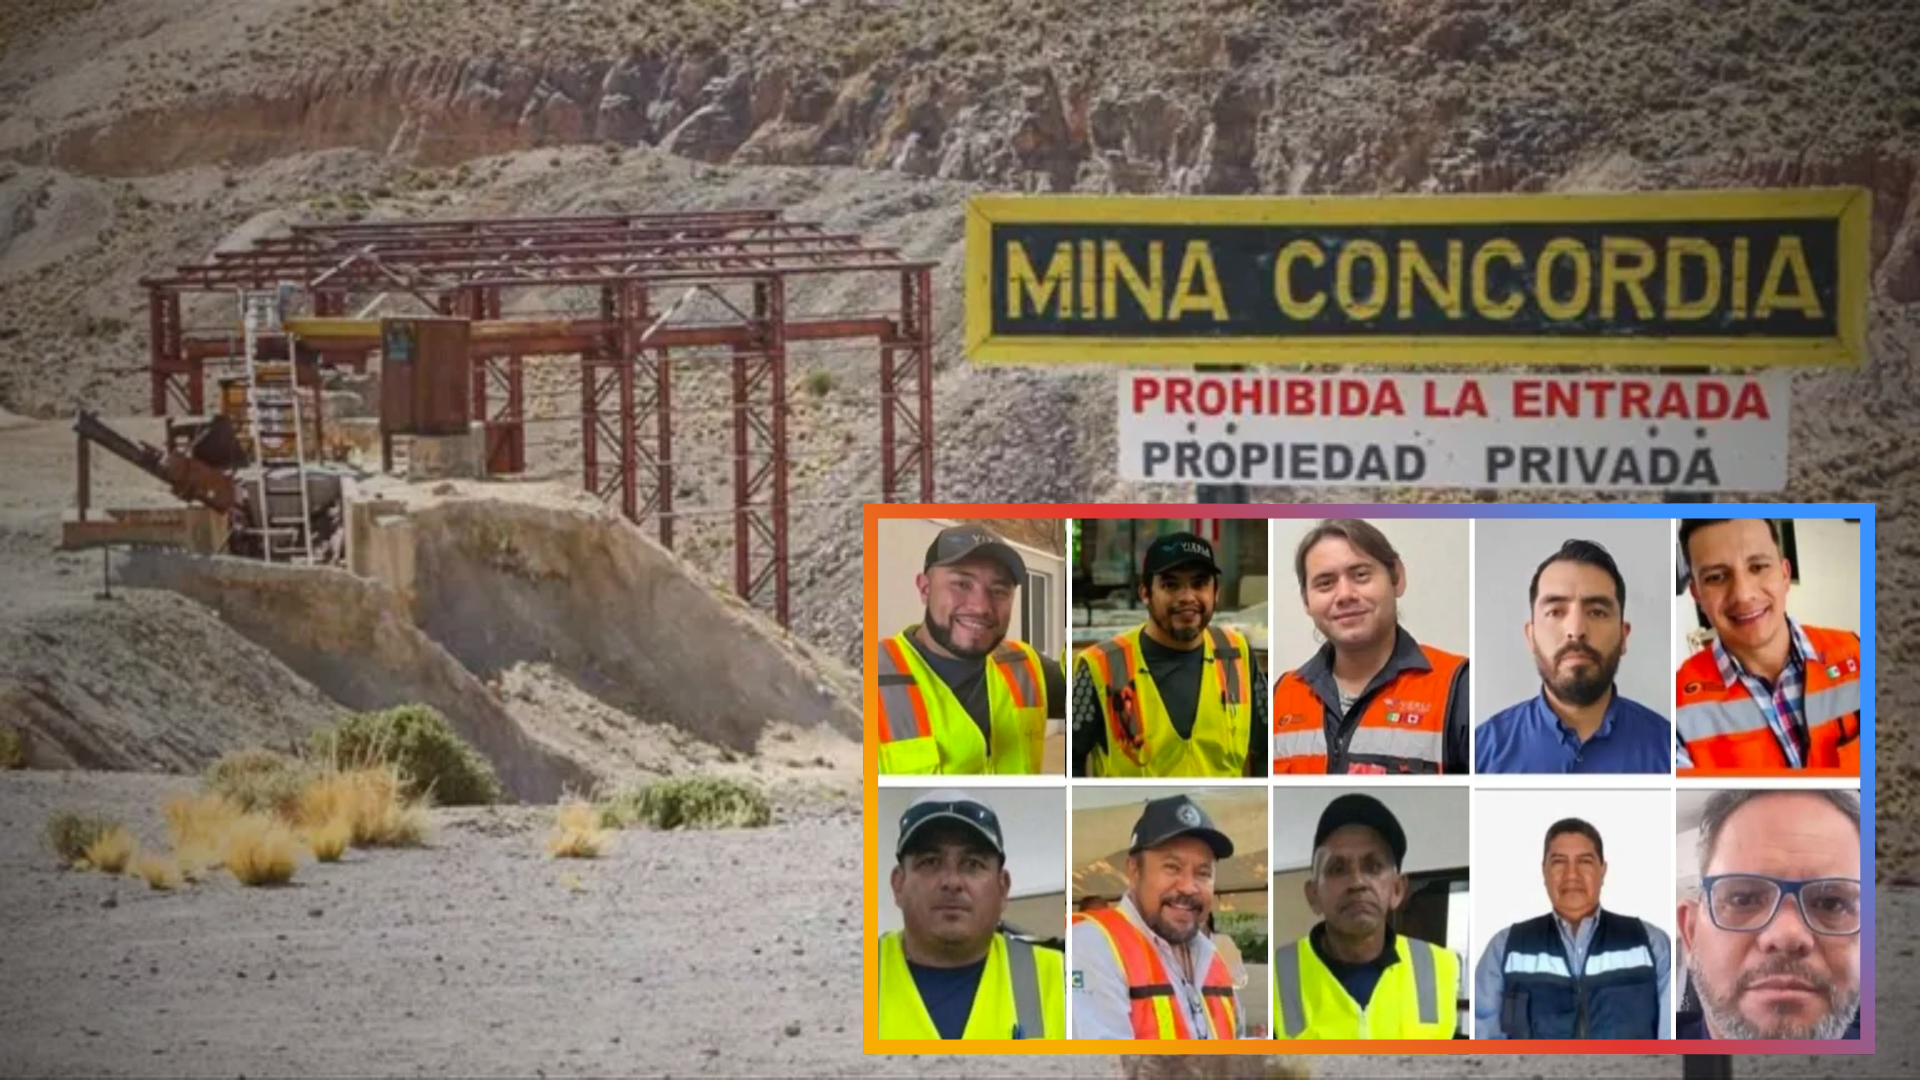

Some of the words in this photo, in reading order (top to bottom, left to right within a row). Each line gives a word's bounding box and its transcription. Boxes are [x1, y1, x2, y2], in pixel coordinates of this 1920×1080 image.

[1007, 240, 1229, 320] MINA
[1275, 236, 1825, 321] CONCORDIA
[1132, 377, 1404, 416] PROHIBIDA
[1424, 379, 1488, 418] LA
[1512, 380, 1770, 420] ENTRADA
[1142, 442, 1427, 481] PROPIEDAD
[1486, 446, 1720, 485] PRIVADA
